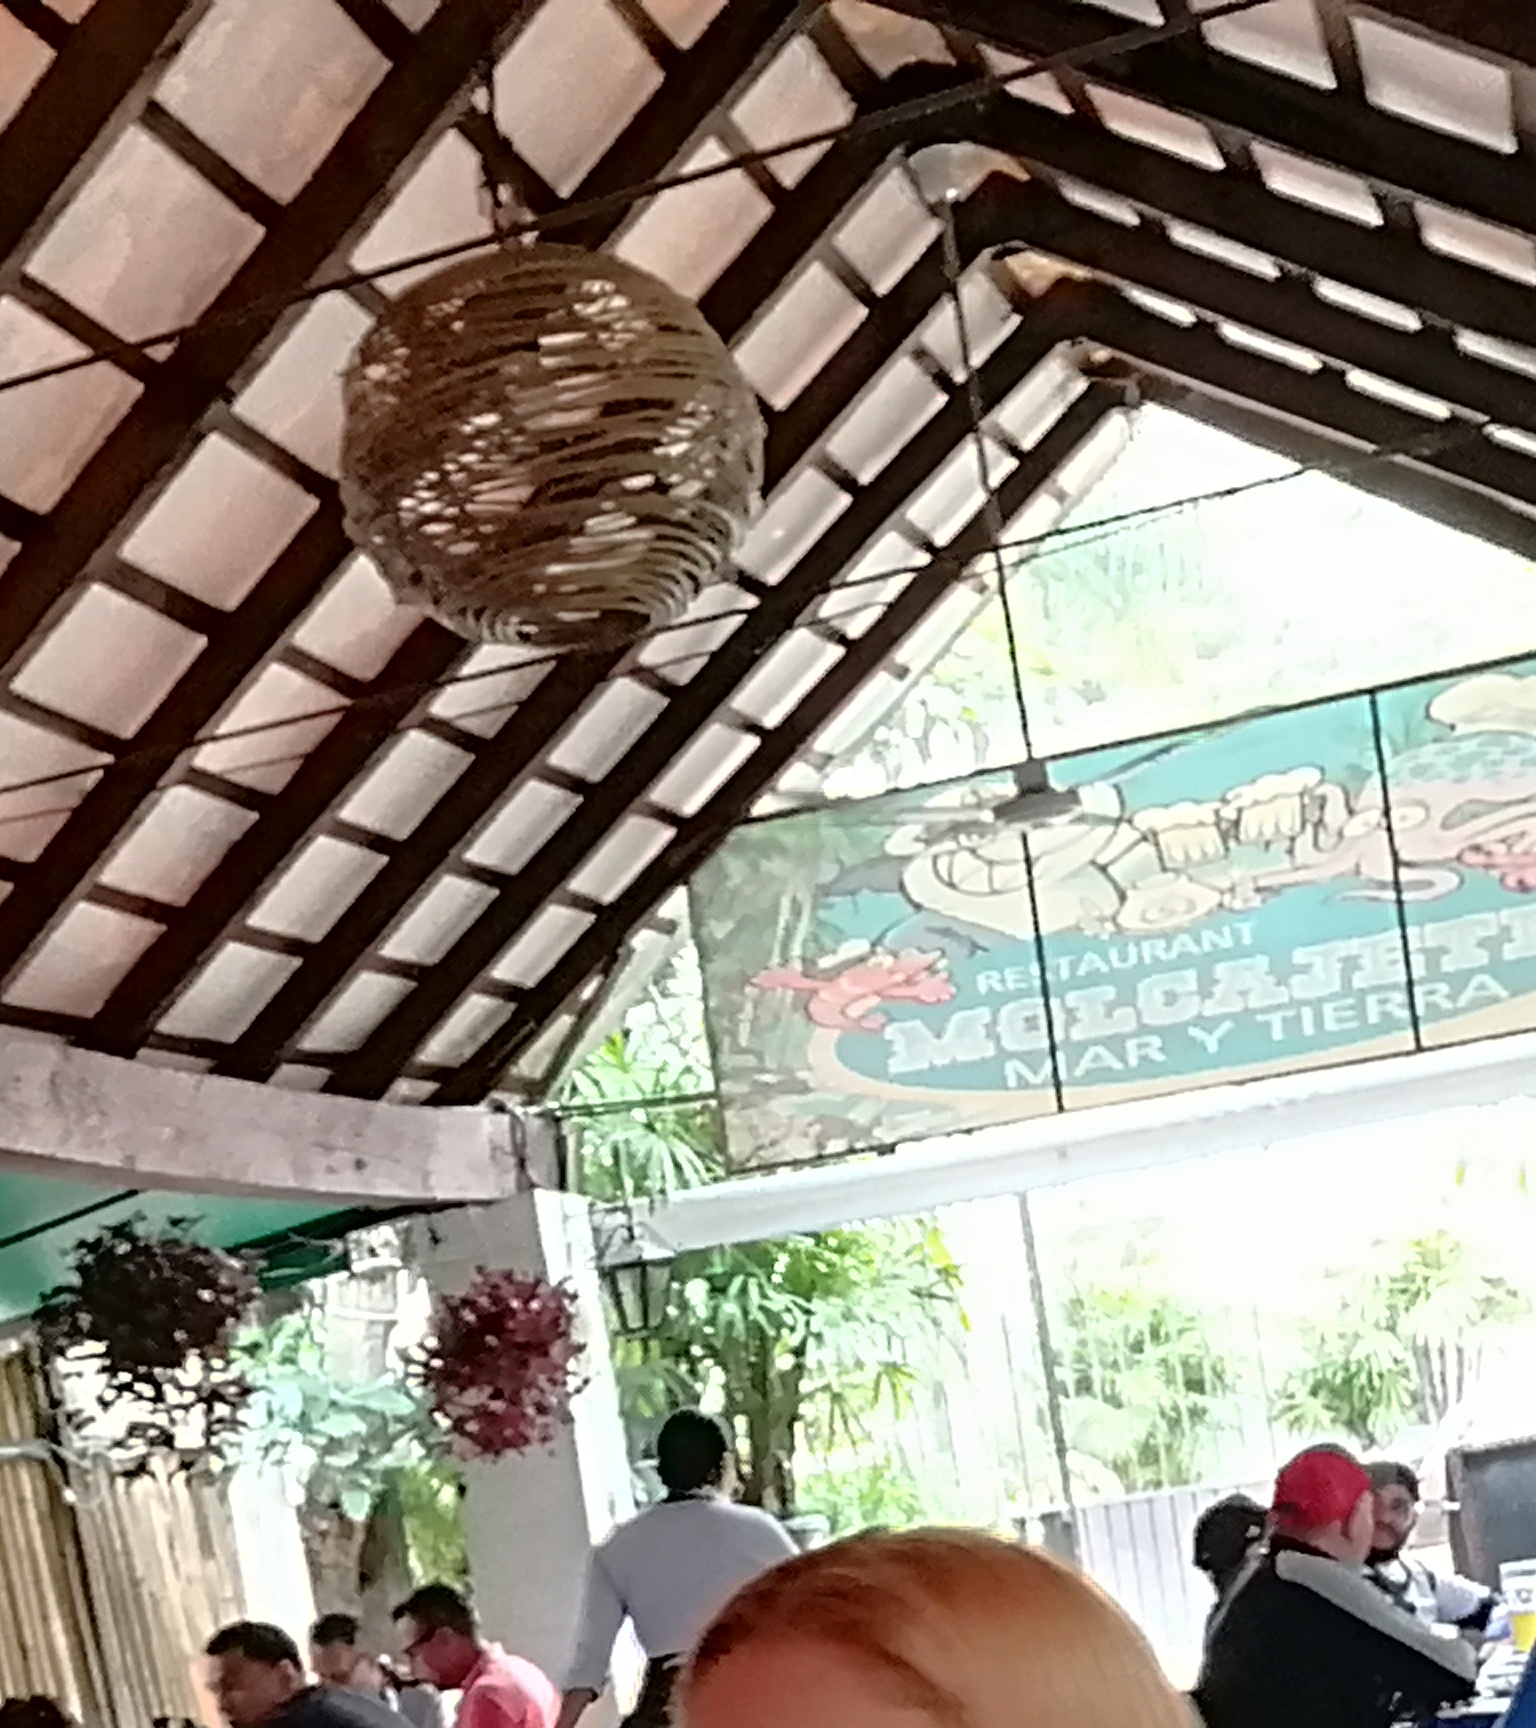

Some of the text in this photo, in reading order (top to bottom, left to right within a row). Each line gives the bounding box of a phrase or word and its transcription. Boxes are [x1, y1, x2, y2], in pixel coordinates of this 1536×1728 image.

[976, 920, 1257, 996] RESTAURANT
[1004, 973, 1511, 1089] MAR Y TIERRA
